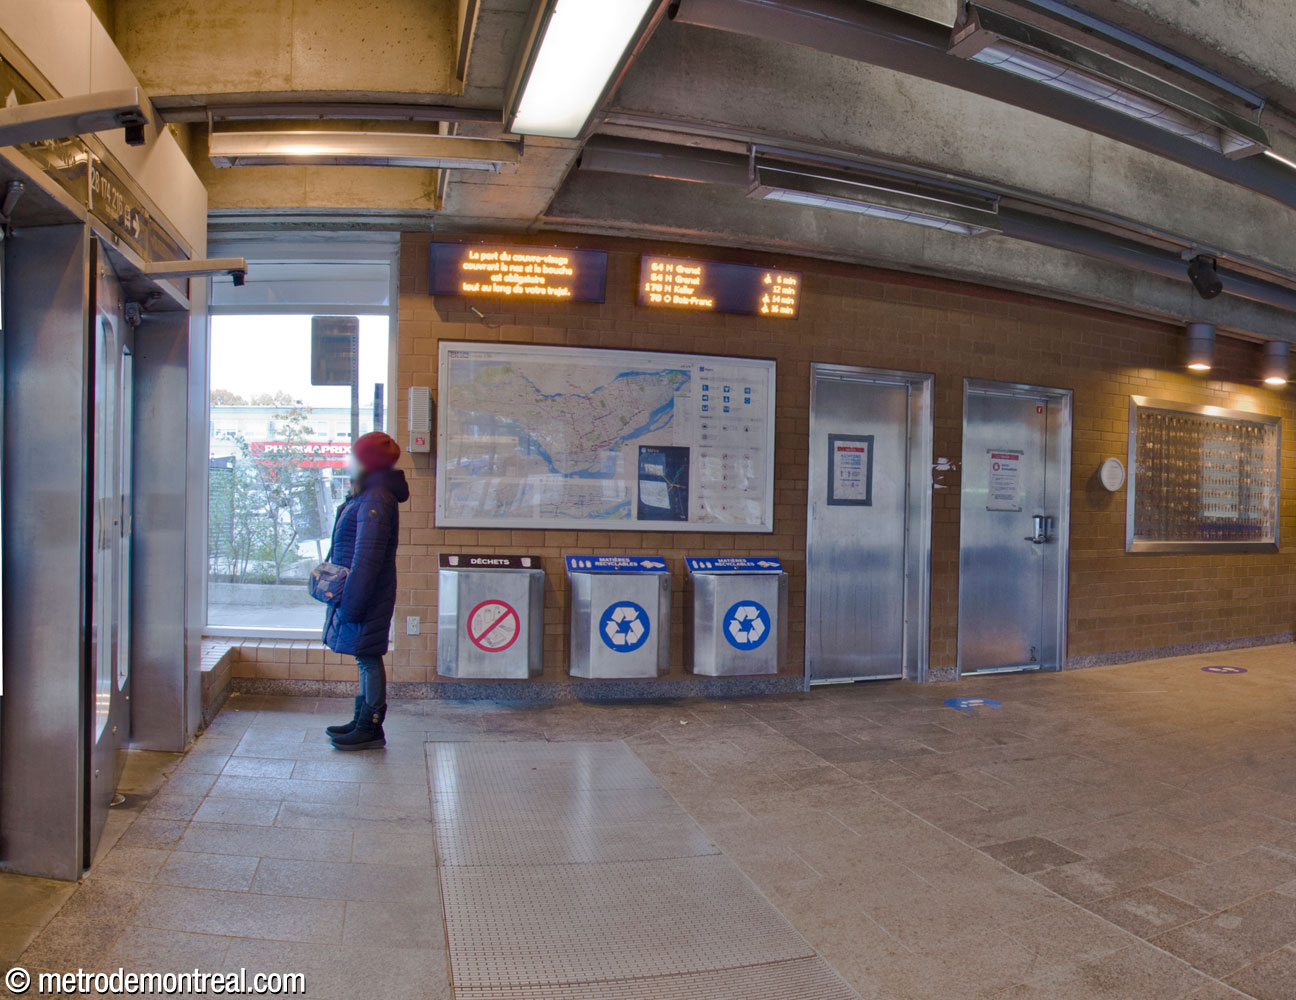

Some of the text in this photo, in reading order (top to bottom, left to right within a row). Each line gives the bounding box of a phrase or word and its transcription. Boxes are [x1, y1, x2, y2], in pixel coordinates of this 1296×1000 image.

[469, 250, 479, 260] Le
[480, 252, 498, 262] port
[500, 251, 512, 261] du
[462, 262, 500, 271] couvrant
[500, 262, 508, 271] le
[509, 264, 524, 272] nez
[524, 264, 532, 272] et
[542, 264, 573, 275] bouche
[651, 262, 701, 275] 64 N Grenet
[490, 273, 545, 284] est obligatoire
[650, 273, 700, 285] 64 N Grenet
[782, 277, 796, 286] min
[462, 282, 480, 292] tout
[481, 284, 492, 292] au
[492, 282, 512, 294] long
[512, 284, 524, 294] de
[524, 286, 546, 294] votre
[664, 284, 672, 292] N
[772, 285, 796, 295] 12 min
[772, 295, 794, 304] 14 min
[780, 306, 794, 314] min
[470, 558, 510, 566] DÉCHETS
